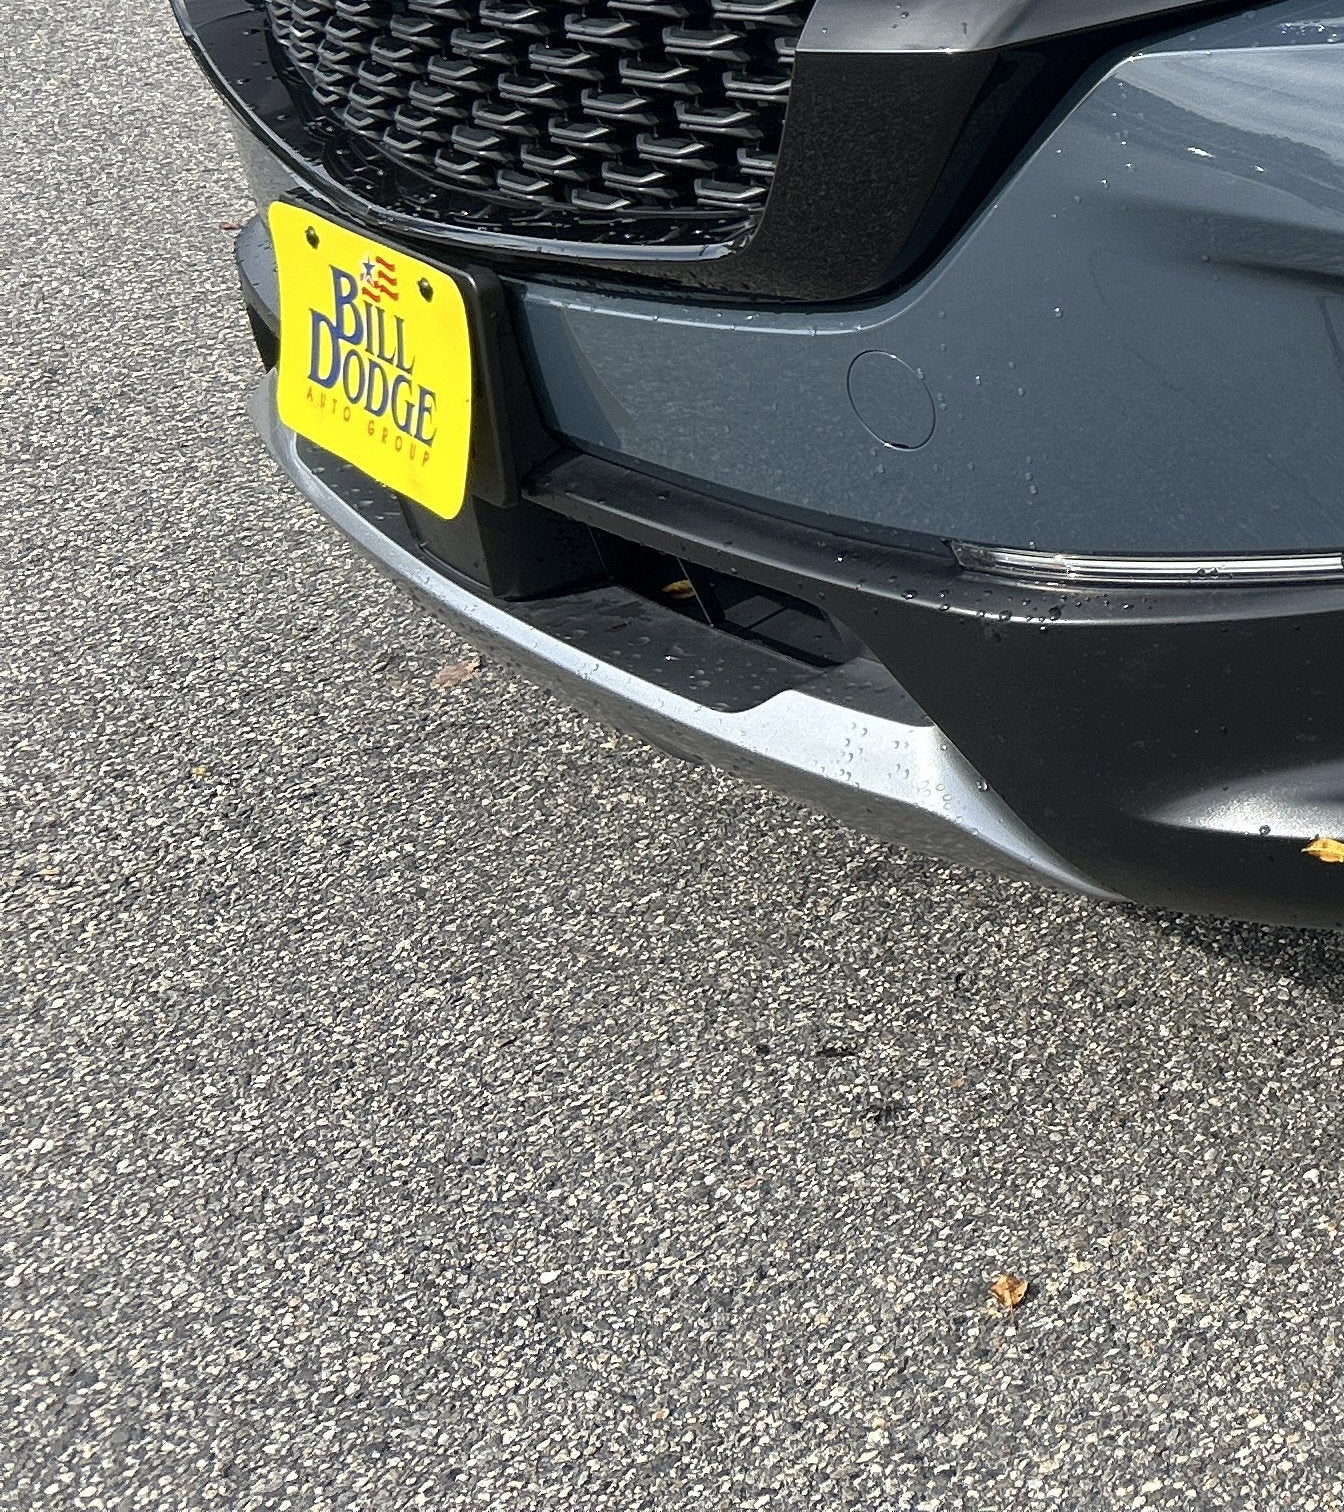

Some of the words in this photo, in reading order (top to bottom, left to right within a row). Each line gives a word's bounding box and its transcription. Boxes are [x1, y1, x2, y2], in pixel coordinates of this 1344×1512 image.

[328, 264, 415, 375] BILL
[306, 386, 351, 423] AUTO
[367, 419, 431, 467] GROUP
[308, 308, 437, 447] DODGE
